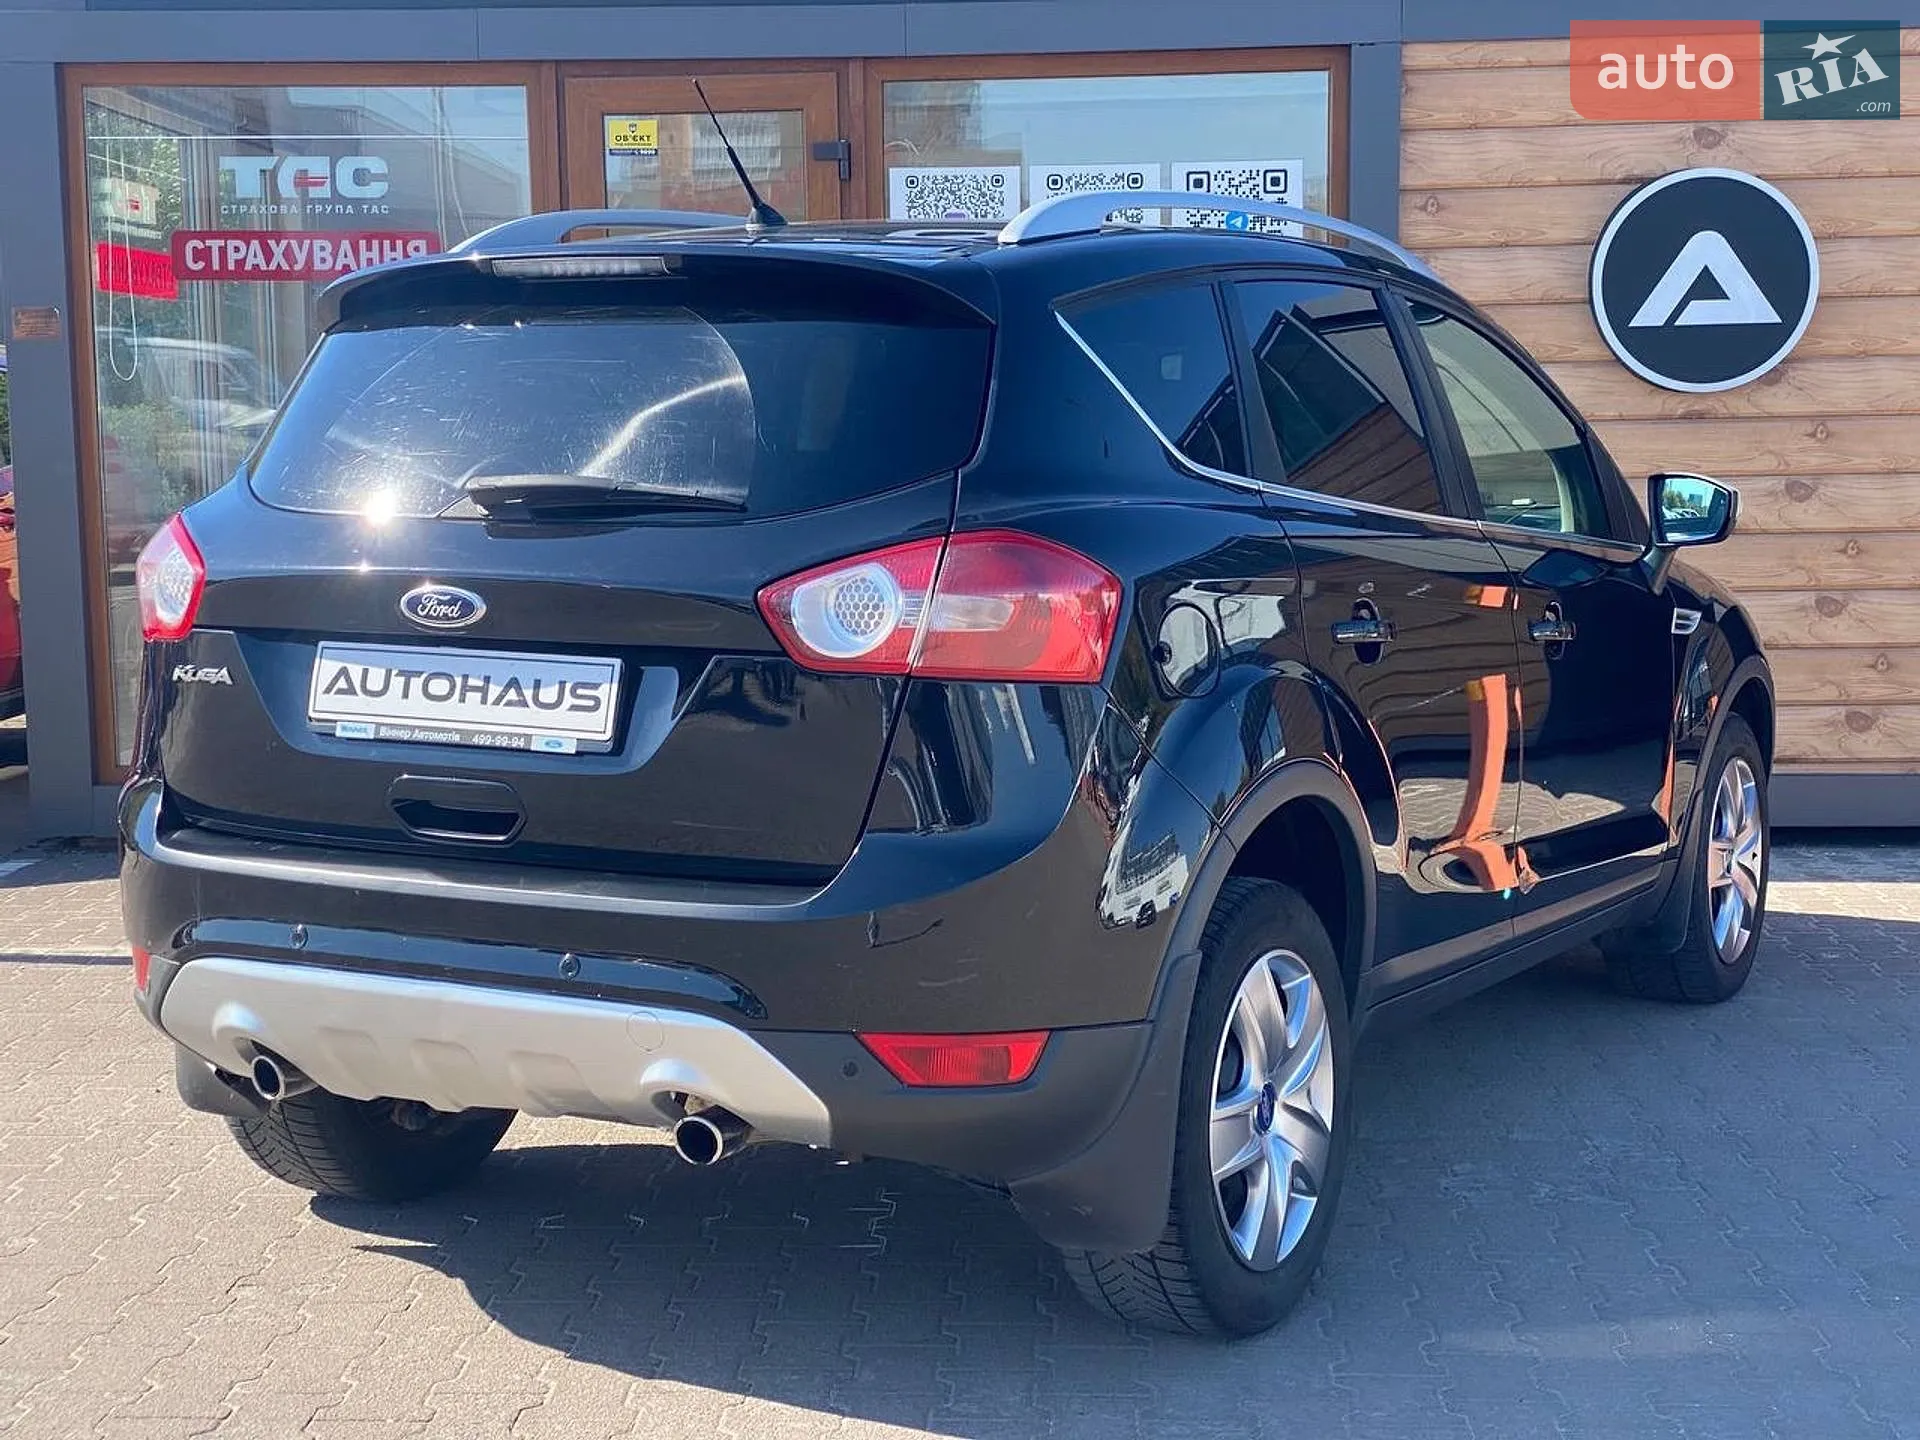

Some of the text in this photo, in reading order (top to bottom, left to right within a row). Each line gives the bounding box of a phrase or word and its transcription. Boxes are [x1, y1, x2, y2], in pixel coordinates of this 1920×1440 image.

[220, 204, 390, 214] СТРАХОВА ГРУПА ТАС
[184, 239, 428, 272] СТРАХУВАННЯ
[416, 594, 462, 618] Ford
[172, 664, 233, 685] KUGA
[322, 665, 602, 713] AUTOHAUS
